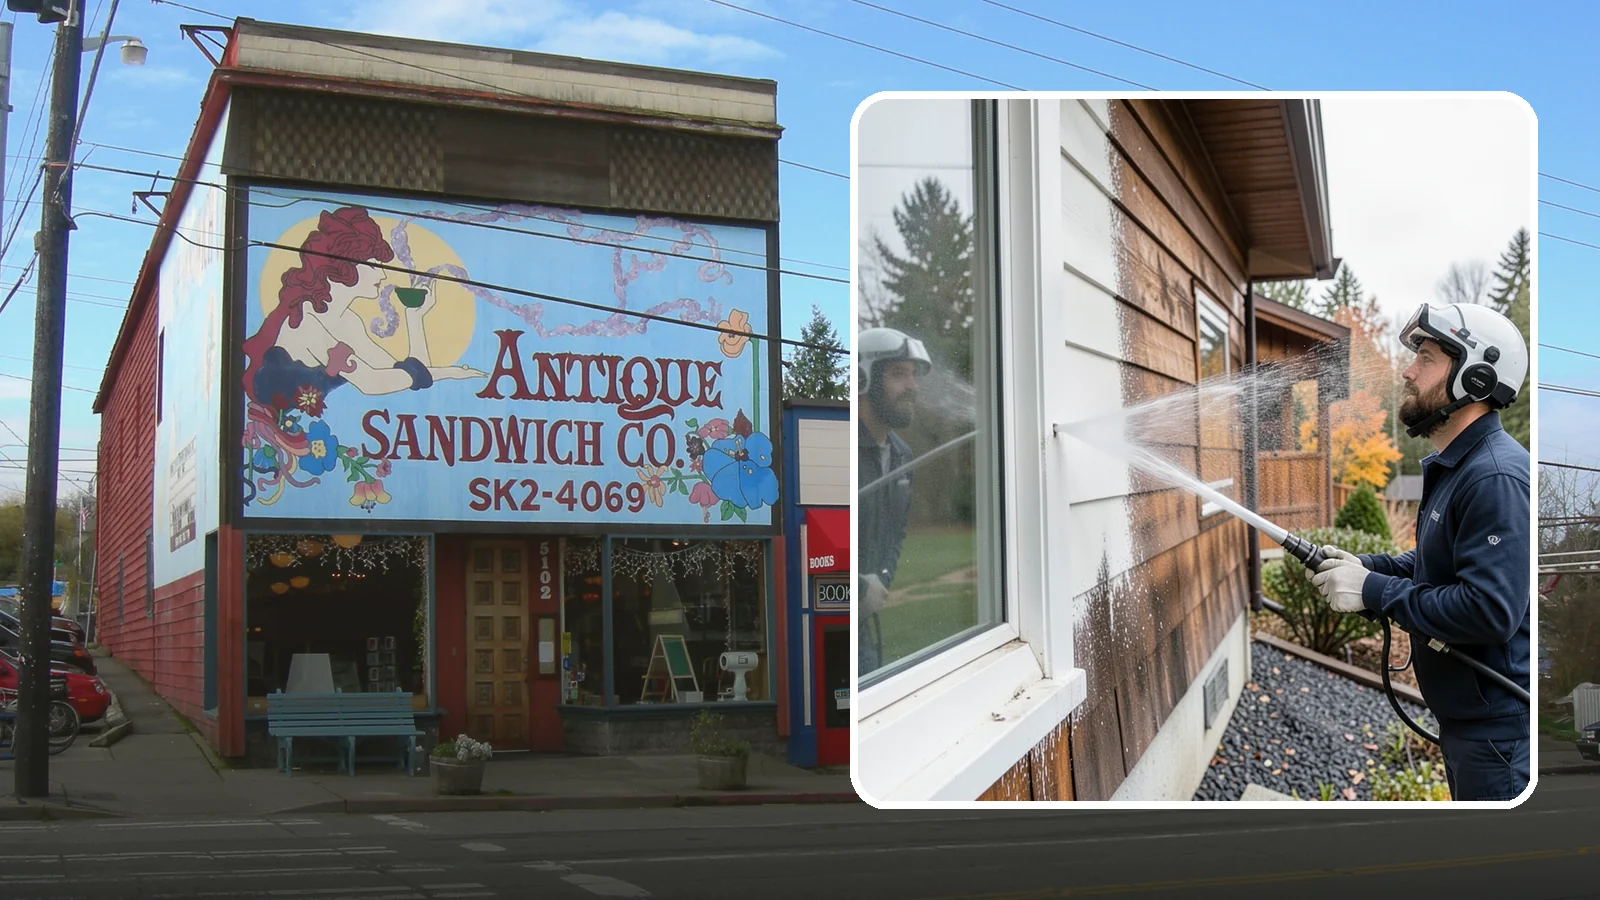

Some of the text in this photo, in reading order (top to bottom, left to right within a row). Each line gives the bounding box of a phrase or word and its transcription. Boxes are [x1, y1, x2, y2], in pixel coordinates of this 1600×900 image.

[475, 328, 724, 421] ANTIQUE
[361, 408, 685, 469] SANDWICH CO.
[467, 476, 646, 513] SK2-4069
[540, 542, 552, 600] 5102
[809, 555, 834, 569] BOOKS
